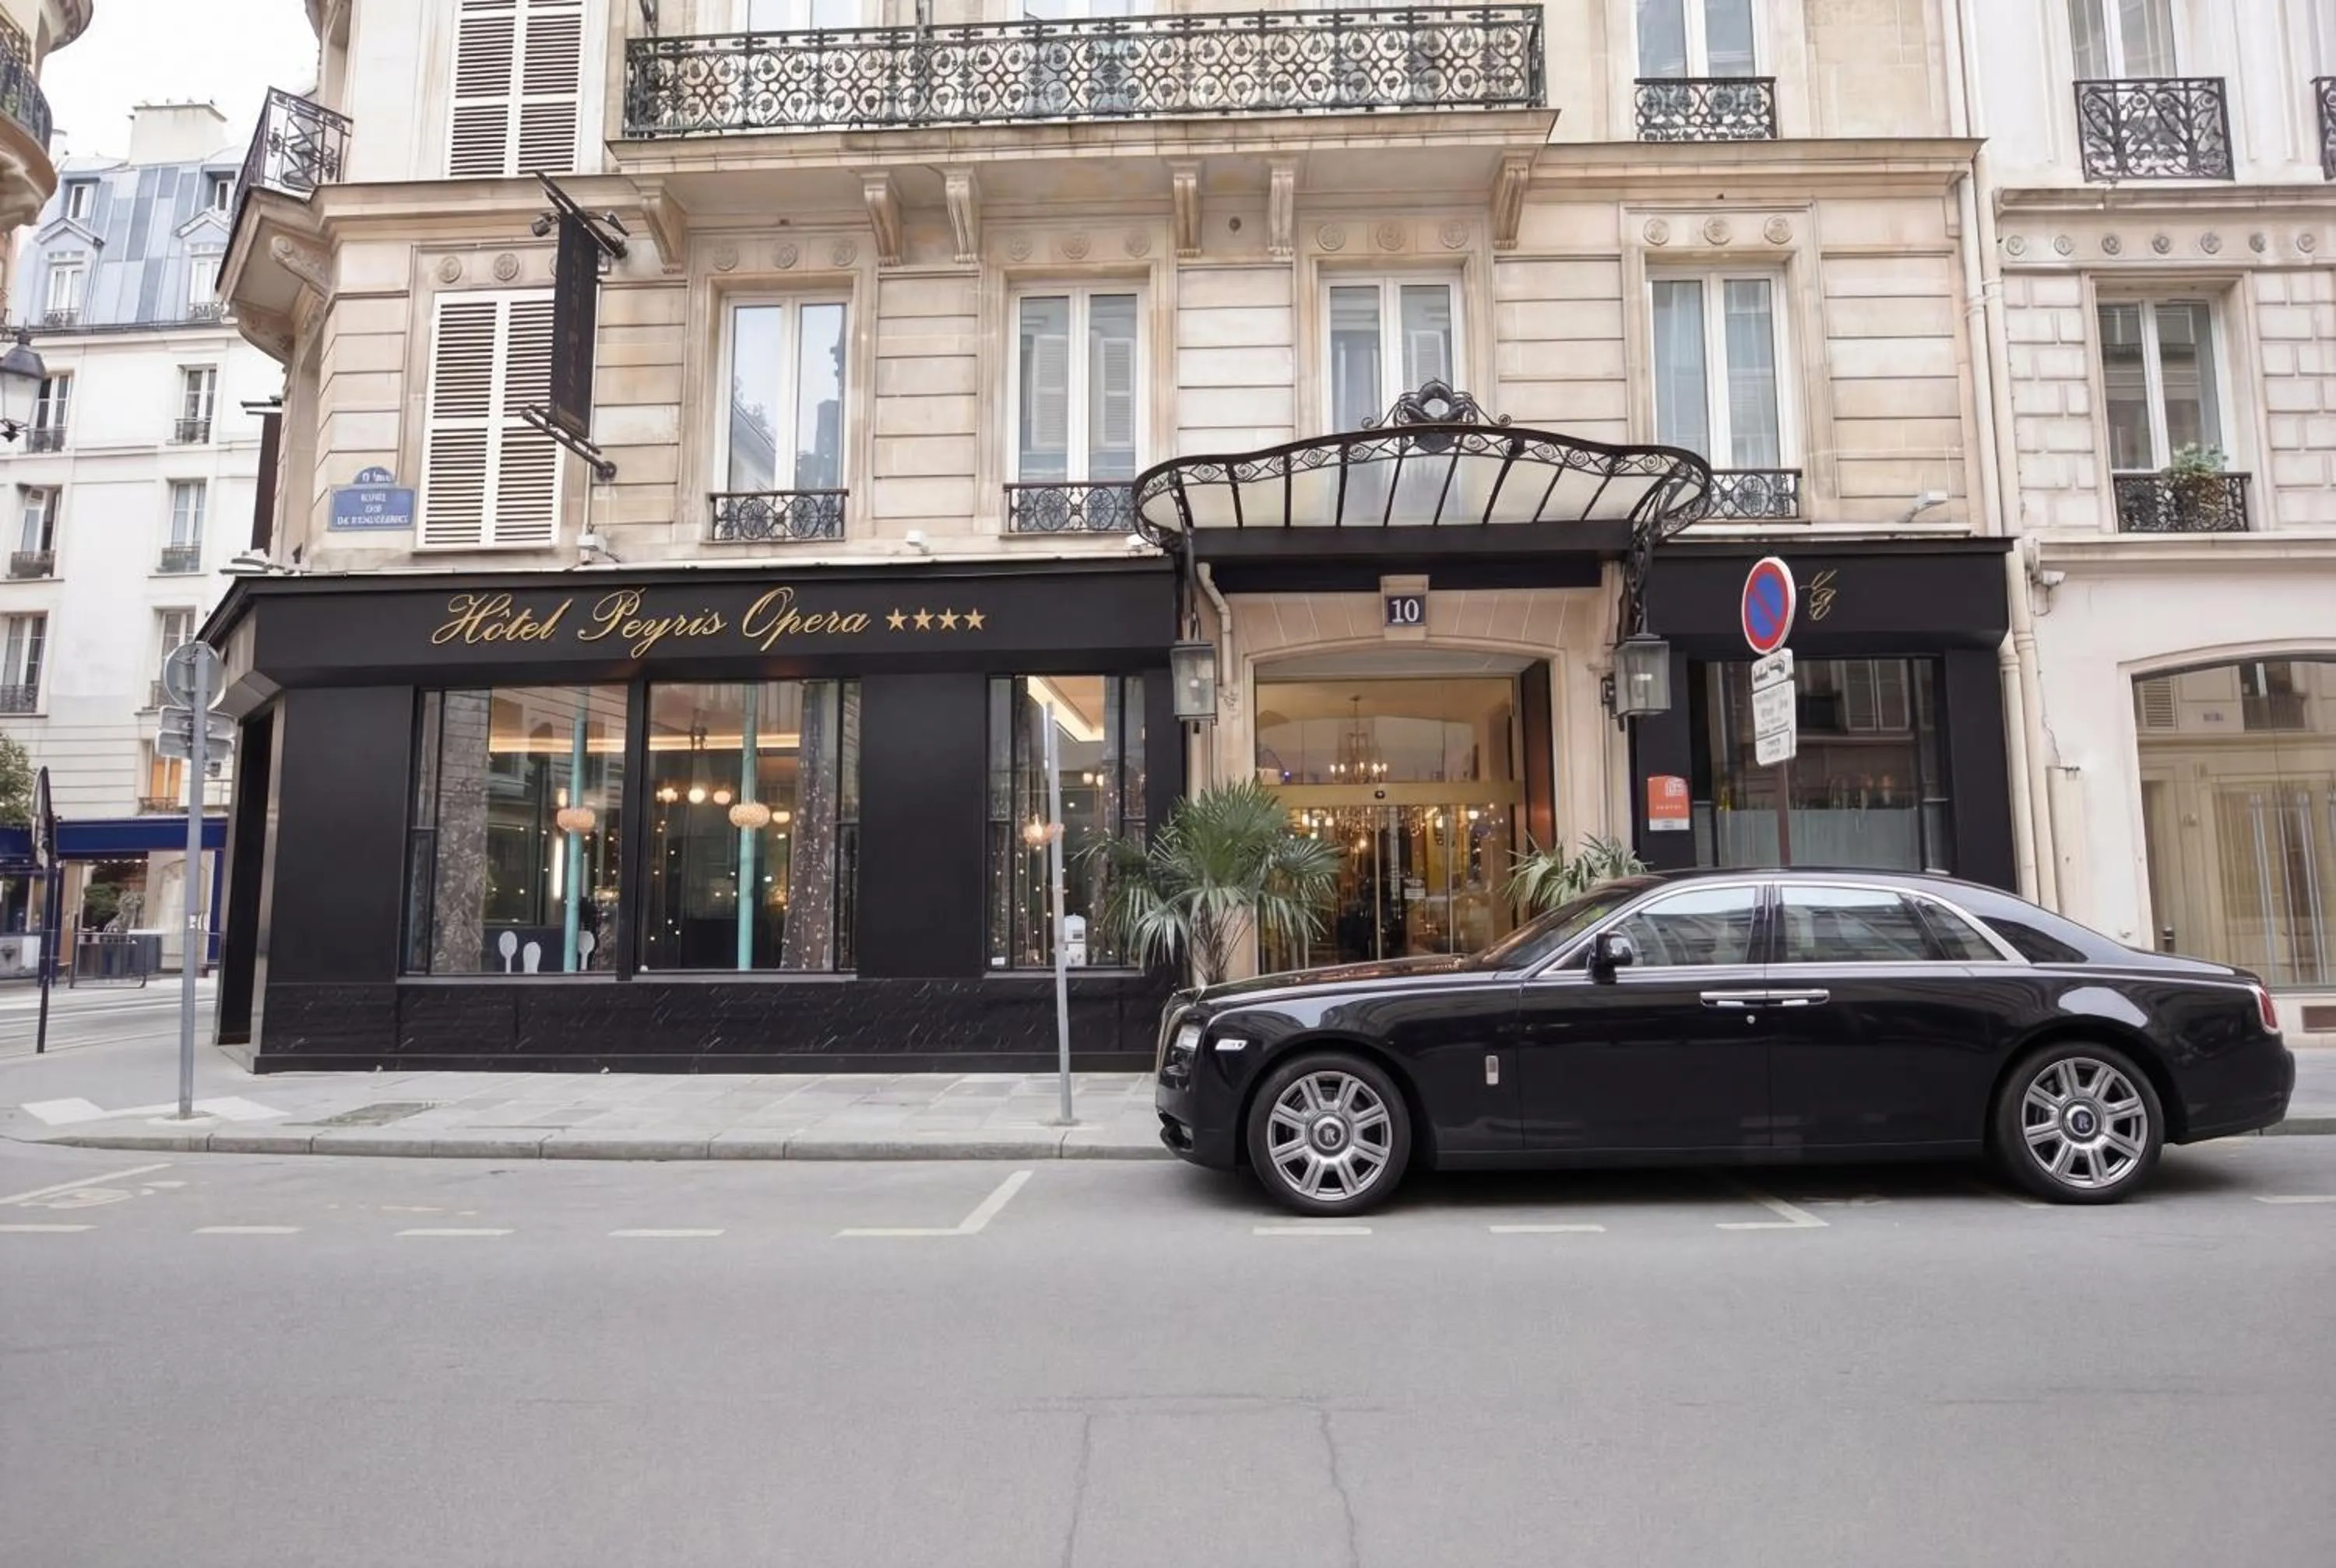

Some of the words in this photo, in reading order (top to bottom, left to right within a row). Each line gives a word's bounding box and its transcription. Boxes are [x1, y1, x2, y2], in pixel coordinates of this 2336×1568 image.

[432, 592, 573, 644] Hôtel
[577, 587, 727, 659] Peyris
[742, 586, 871, 652] Opera
[1391, 599, 1420, 623] 10
